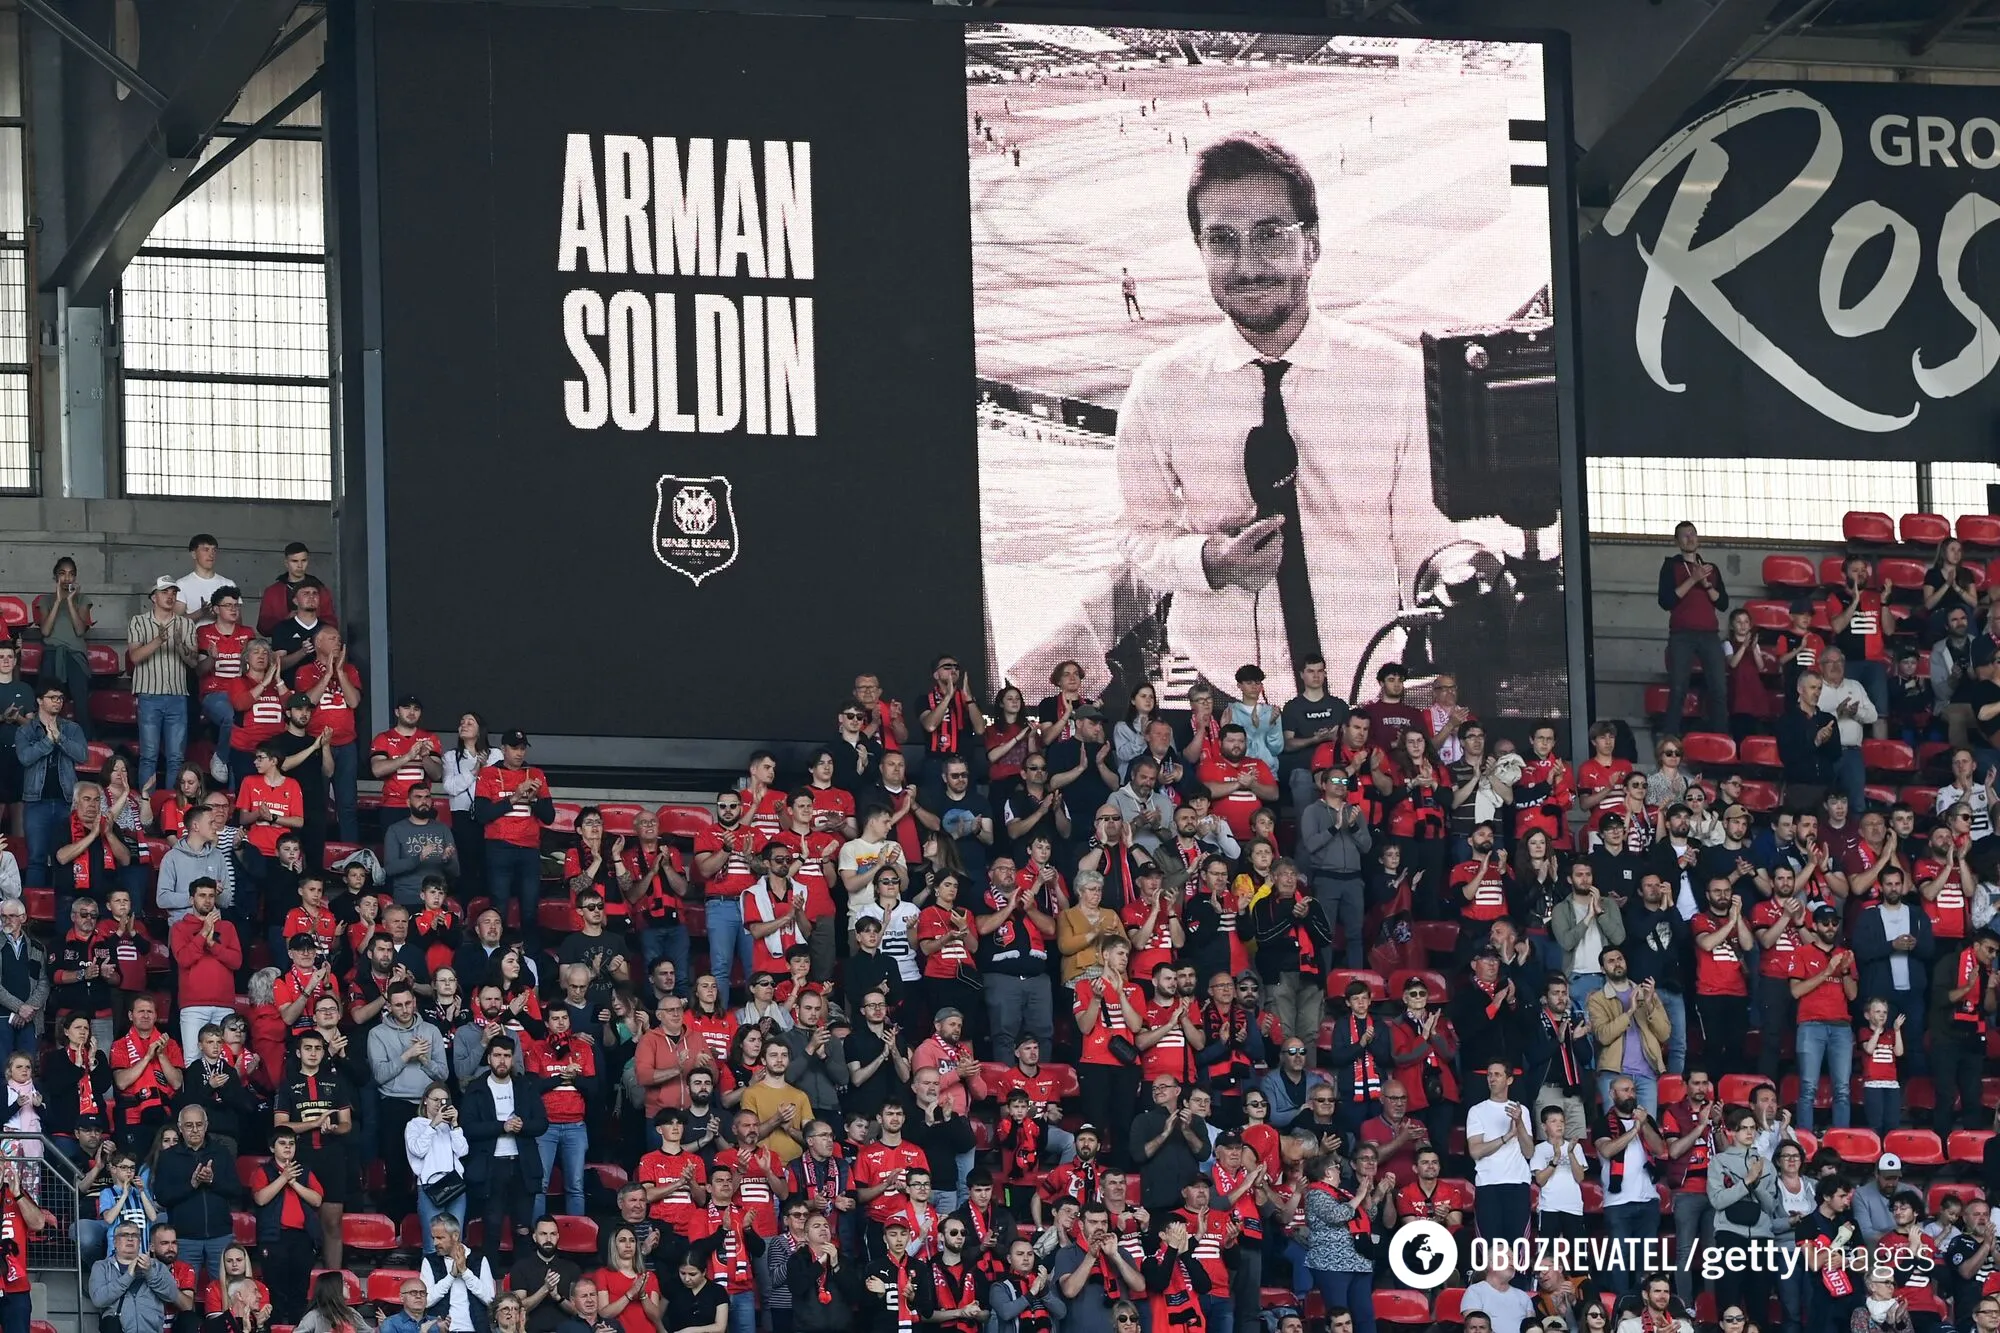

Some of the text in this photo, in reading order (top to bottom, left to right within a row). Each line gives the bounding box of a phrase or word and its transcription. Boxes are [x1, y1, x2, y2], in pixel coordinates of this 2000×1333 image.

[558, 133, 814, 280] ARMAN
[562, 287, 818, 437] SOLDIN
[1382, 717, 1411, 726] REEBOK
[407, 845, 444, 854] JOES
